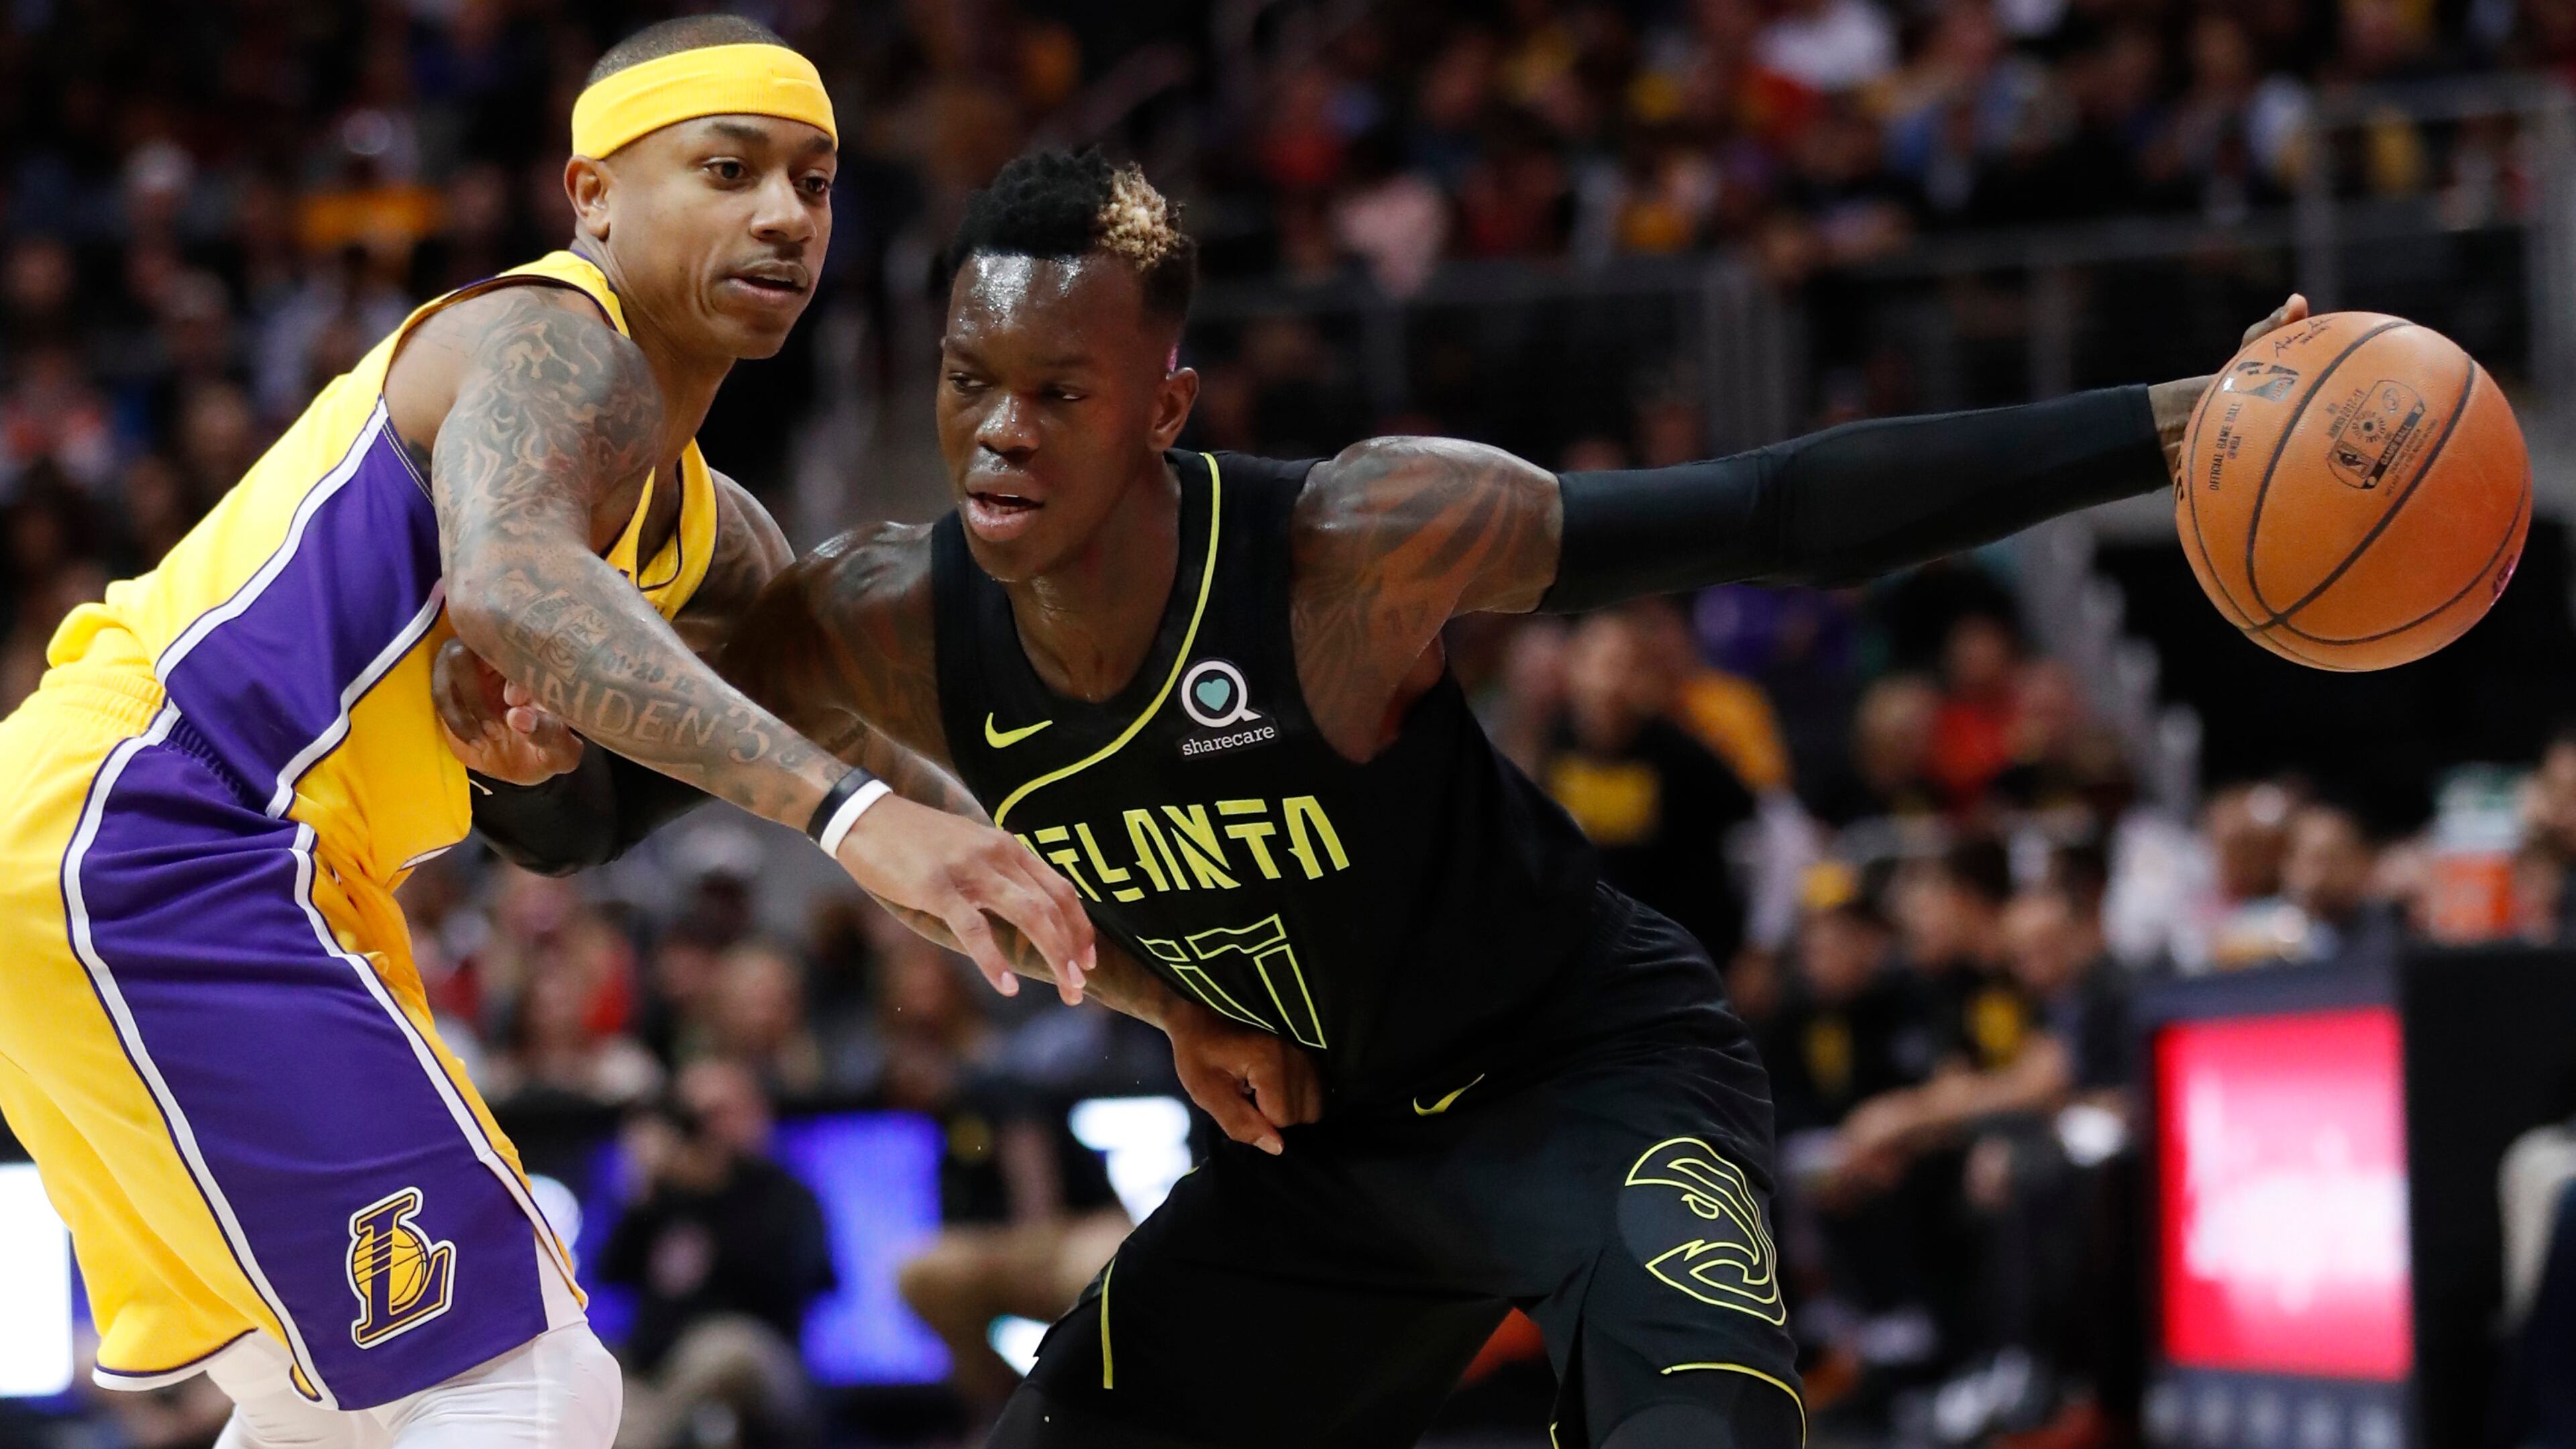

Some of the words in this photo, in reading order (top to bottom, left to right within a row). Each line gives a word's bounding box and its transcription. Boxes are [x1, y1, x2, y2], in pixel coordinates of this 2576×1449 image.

[2224, 402, 2243, 423] BALL
[2217, 422, 2233, 449] GAME
[2208, 453, 2224, 491] OFFICIAL
[1181, 724, 1276, 757] sharecare
